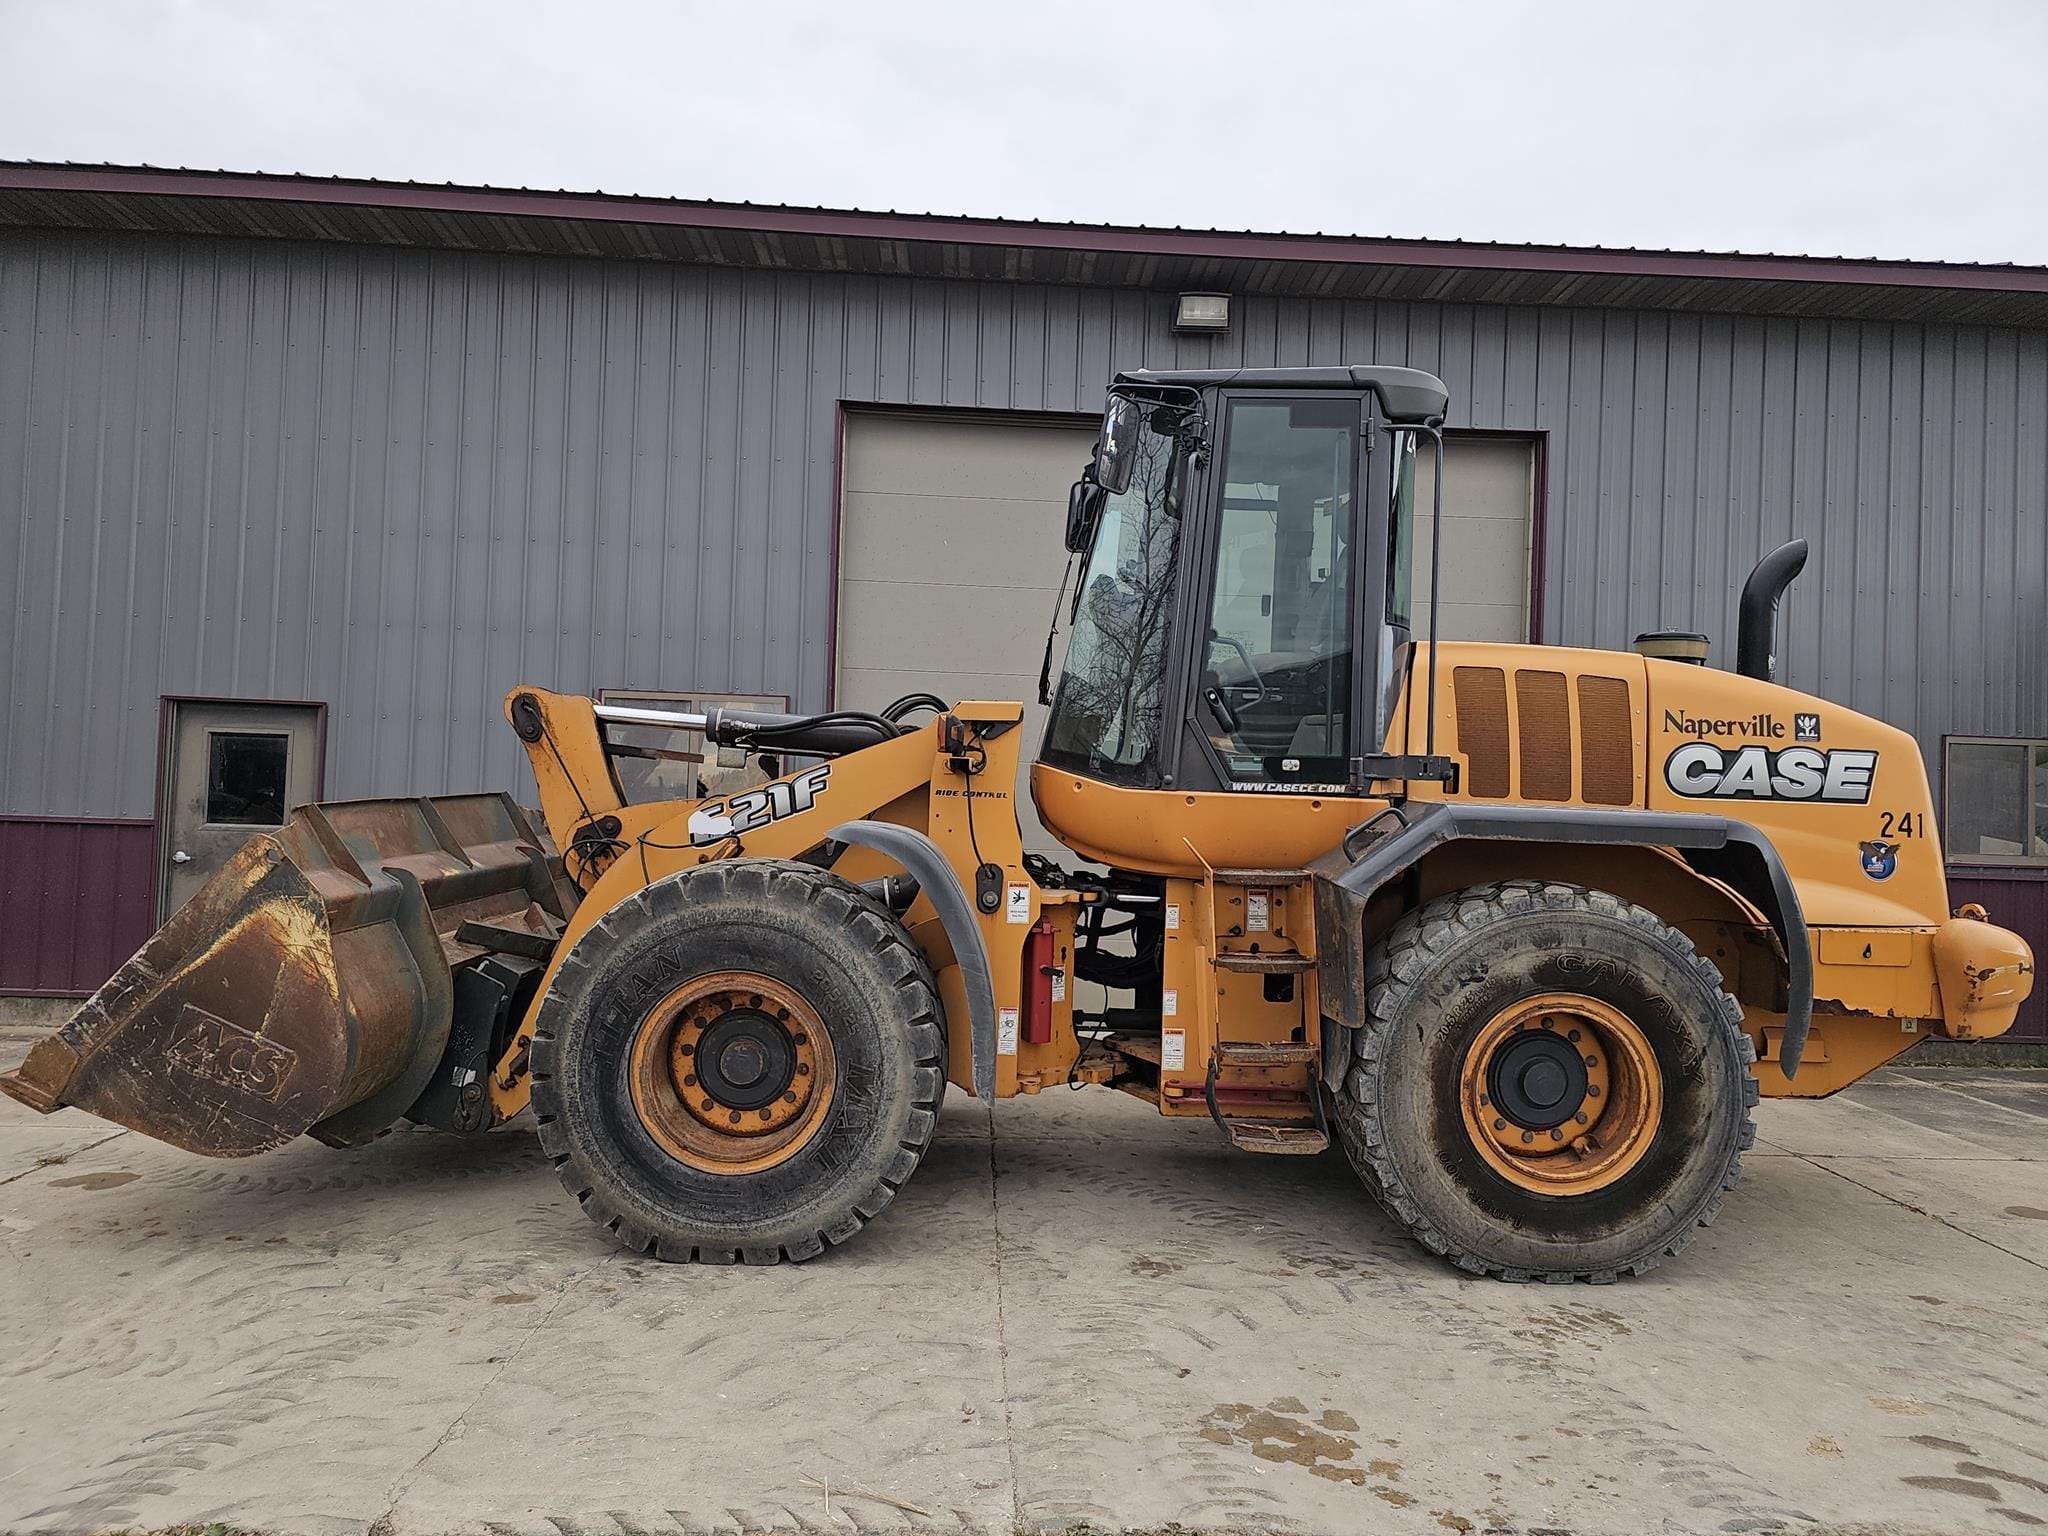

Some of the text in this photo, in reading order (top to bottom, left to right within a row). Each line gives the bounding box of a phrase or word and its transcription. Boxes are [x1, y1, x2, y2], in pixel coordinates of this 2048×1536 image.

[1663, 709, 1785, 739] Naperville
[1232, 781, 1346, 793] WWW.CASECE.COM
[1665, 743, 1878, 801] CASE
[935, 789, 1008, 799] RIDE CONTROL
[1880, 811, 1924, 838] 241
[592, 943, 683, 1069] TITAN
[1556, 952, 1706, 1085] GALAXY
